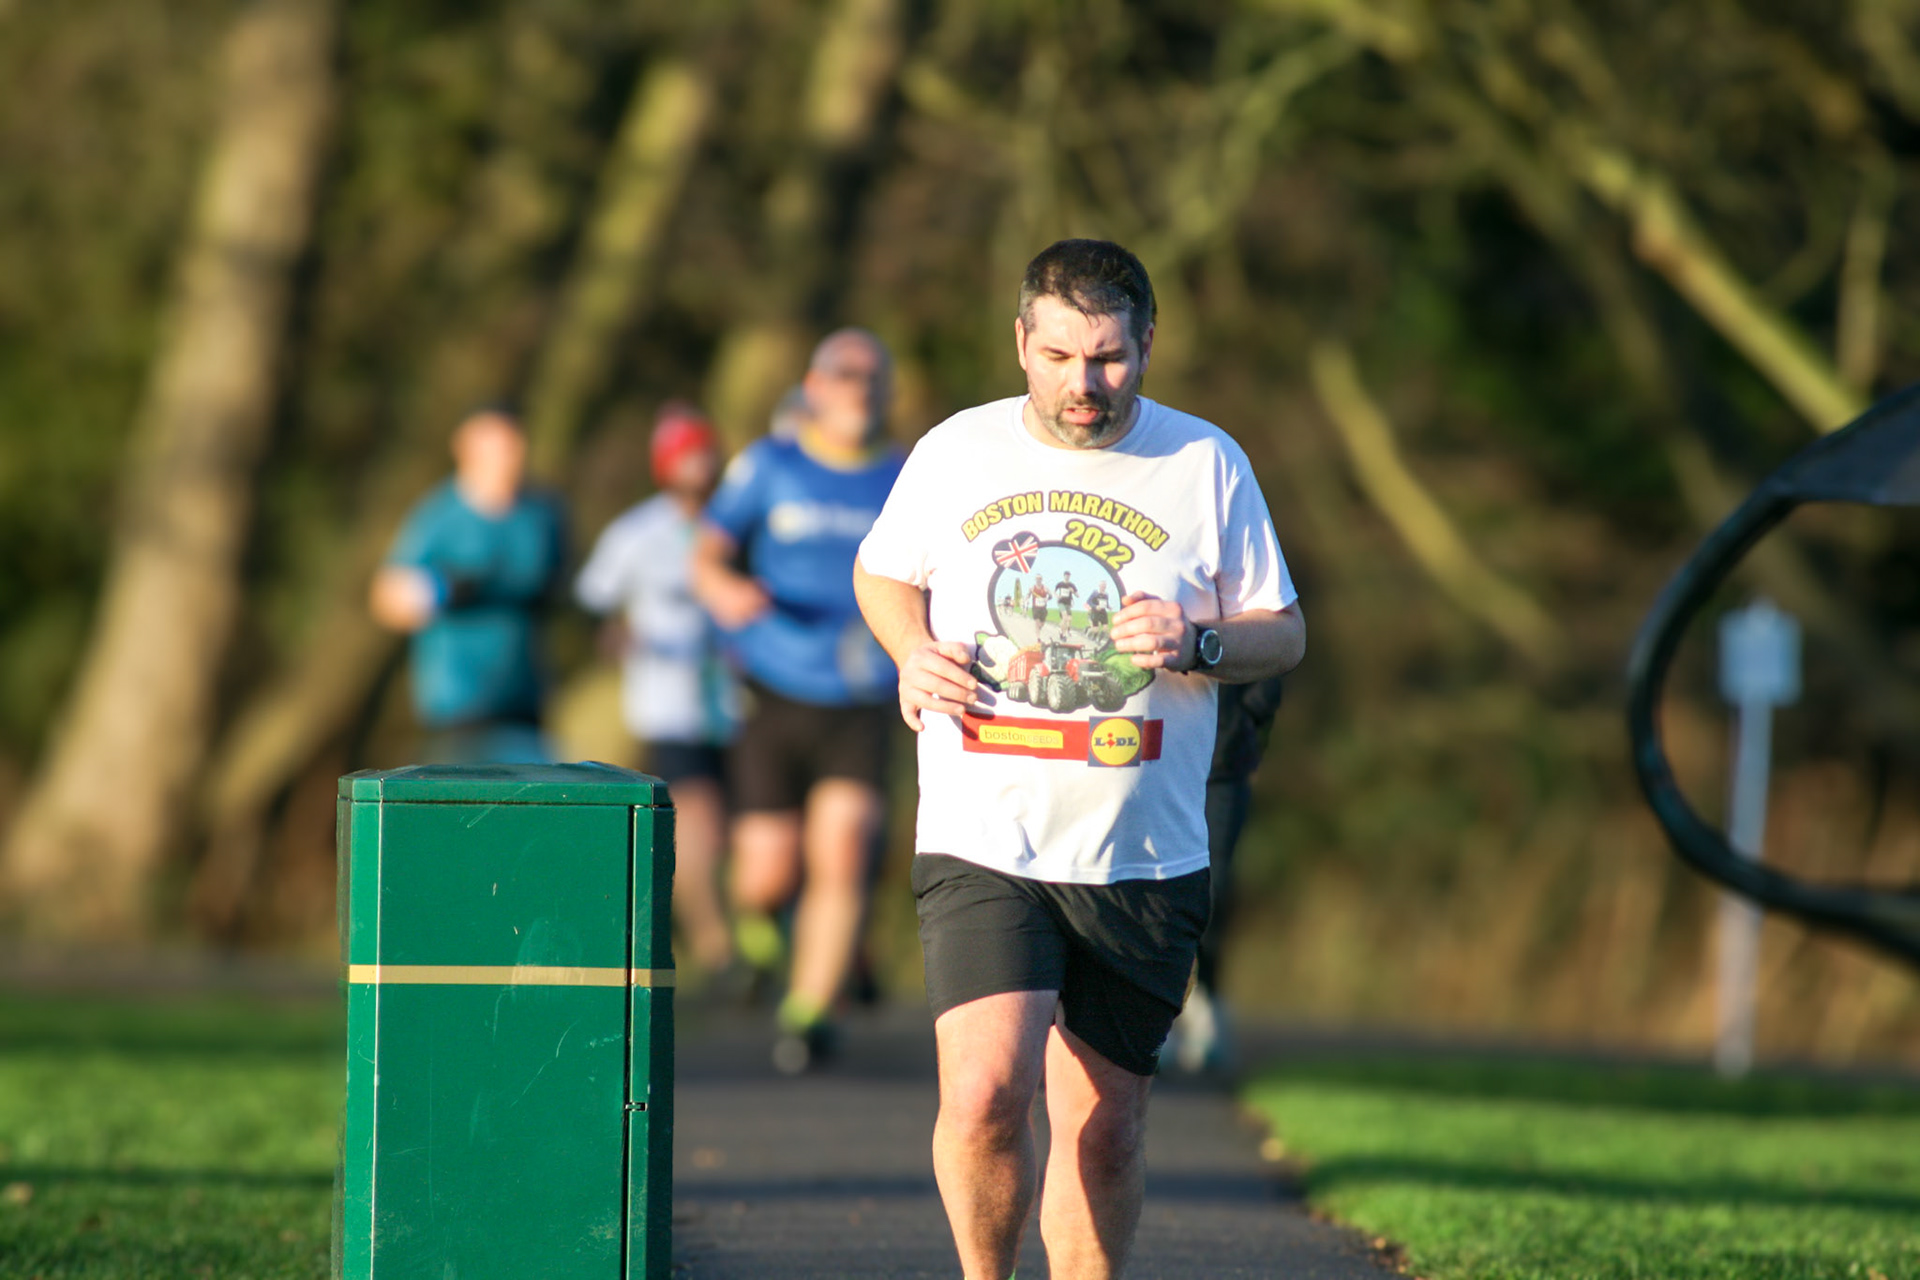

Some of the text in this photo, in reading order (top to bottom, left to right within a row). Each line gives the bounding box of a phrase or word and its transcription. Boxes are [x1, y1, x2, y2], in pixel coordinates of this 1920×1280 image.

[961, 490, 1170, 552] BOSTON MARATHON
[1063, 518, 1135, 571] 2022
